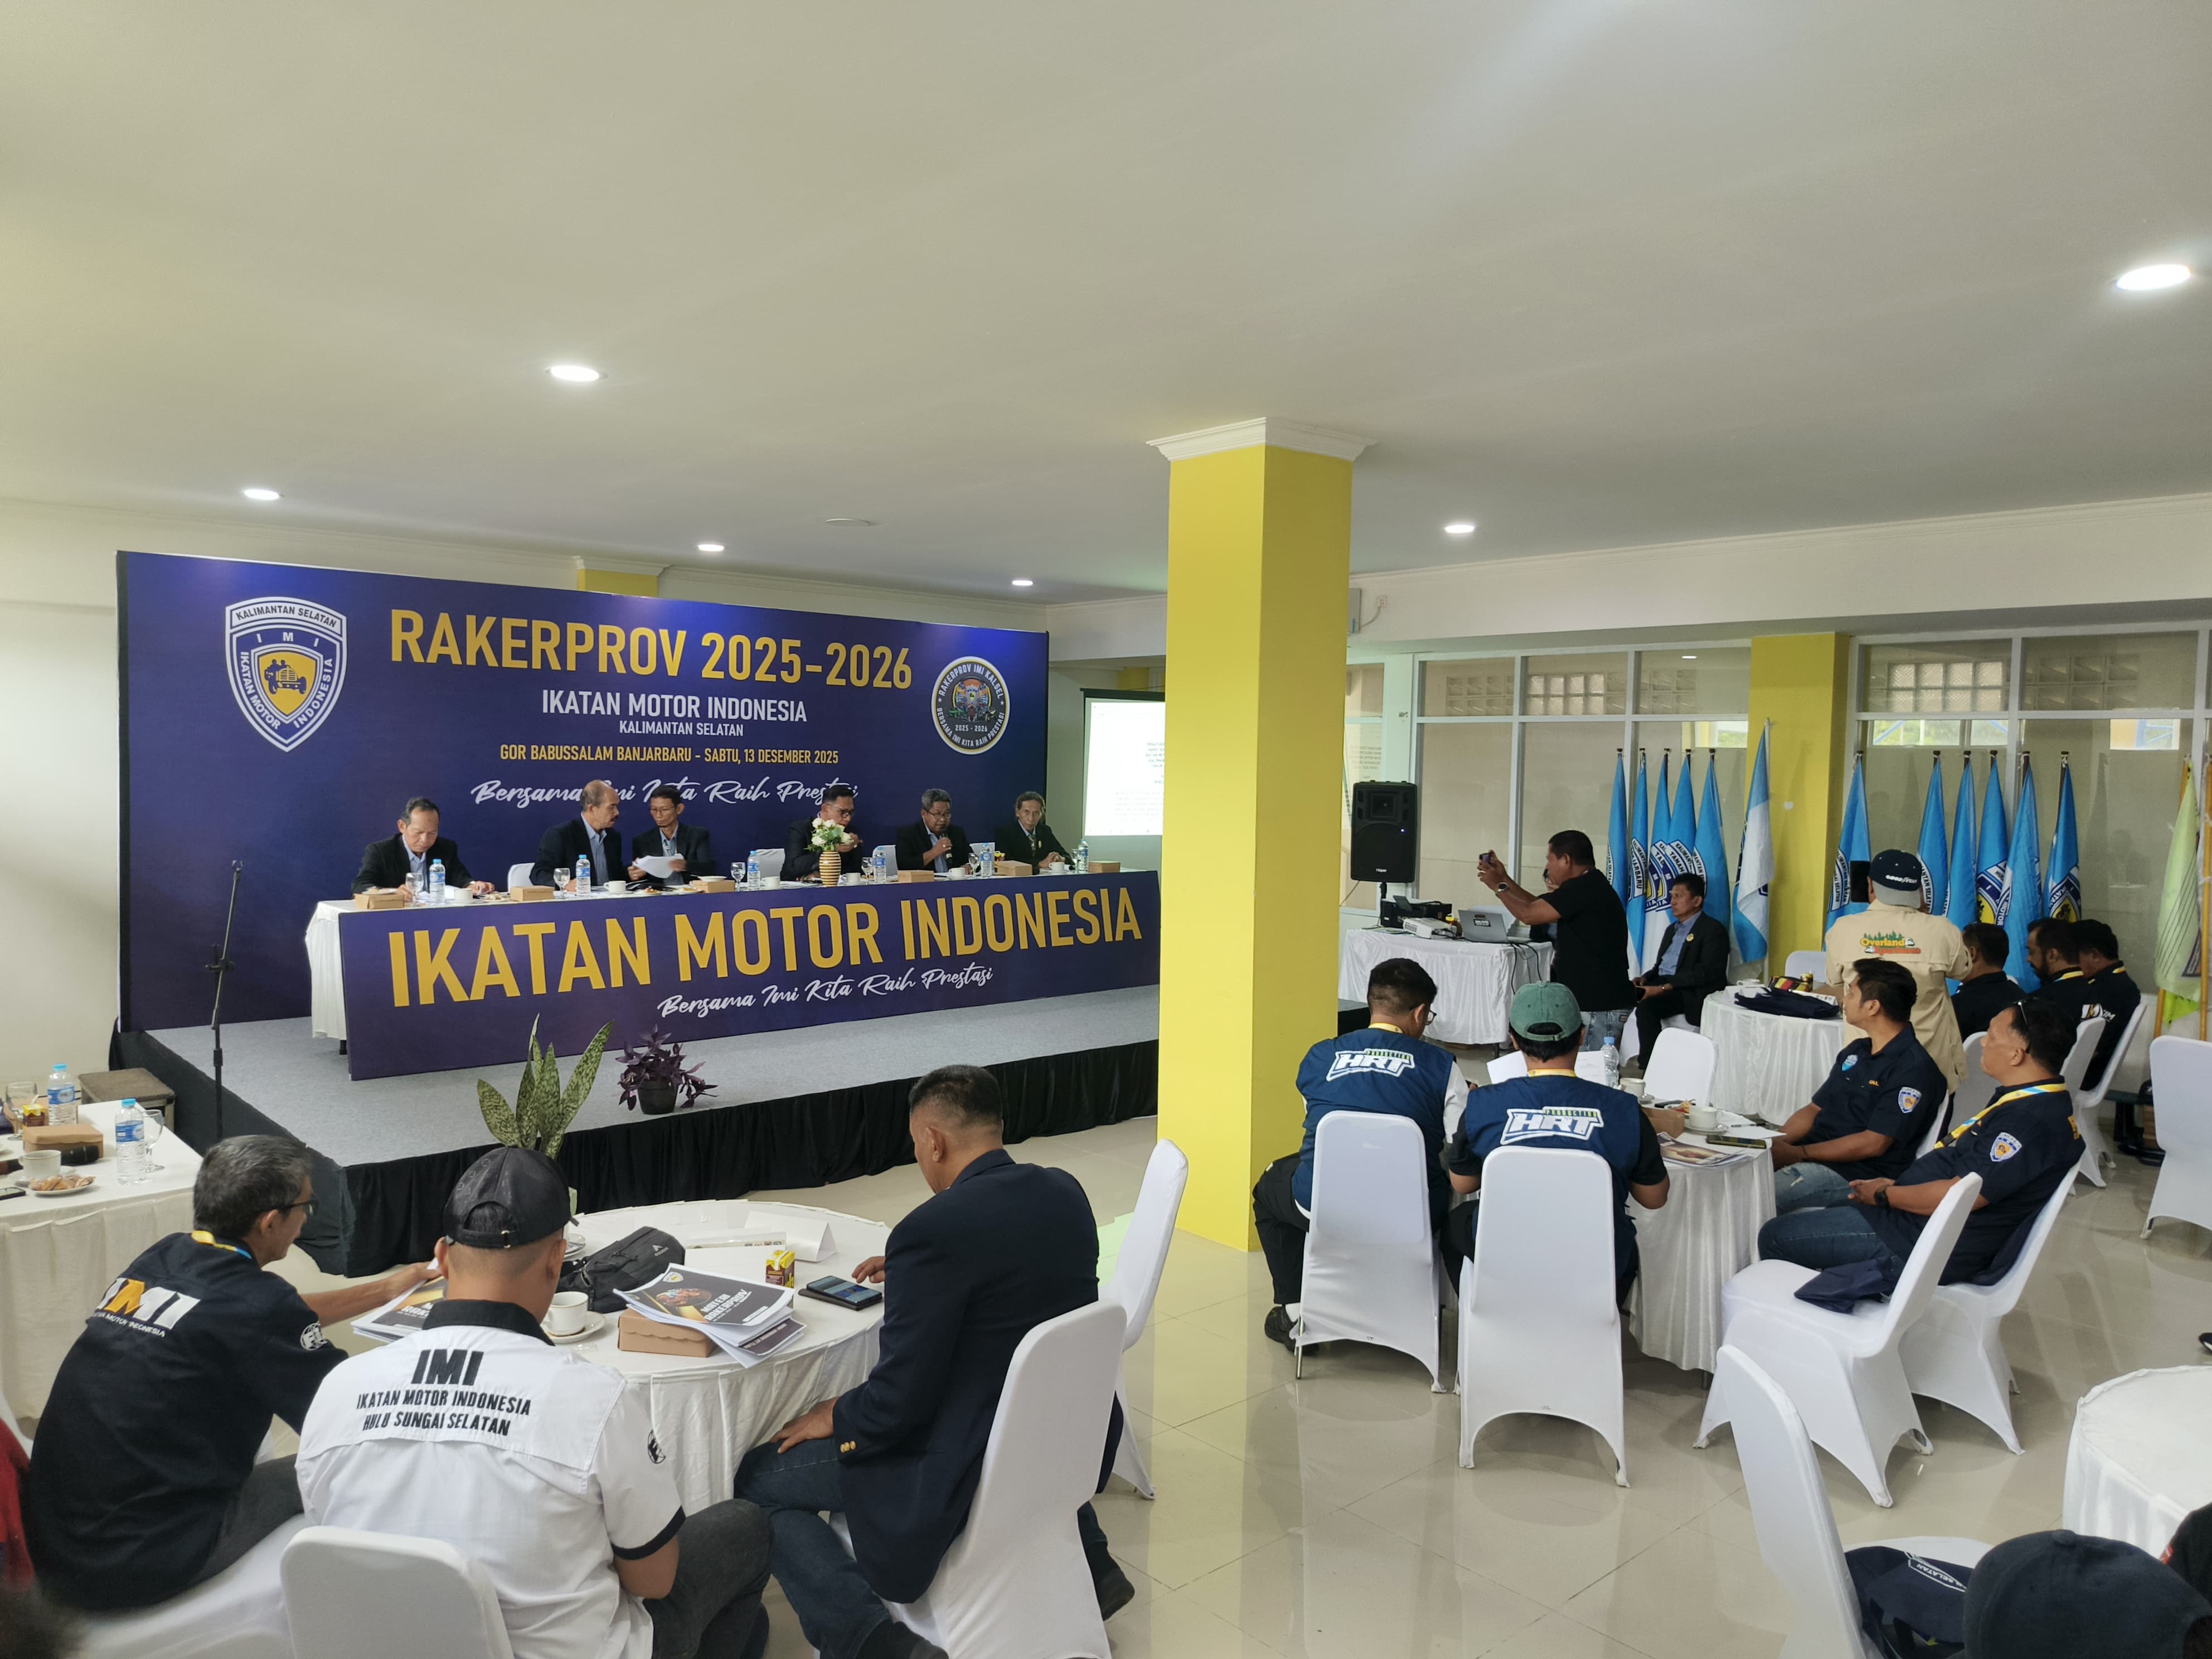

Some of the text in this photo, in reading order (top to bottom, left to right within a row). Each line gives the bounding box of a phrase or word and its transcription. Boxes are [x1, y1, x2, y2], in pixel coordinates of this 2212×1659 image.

[235, 605, 337, 628] KALIMANTAN SELATAN
[391, 609, 913, 689] RAKERPROV 2025-2026
[240, 651, 333, 729] IKATAN MOTOR INDONESIA
[938, 664, 1004, 699] RAKERPROV IMI KALSEL
[542, 690, 807, 722] IKATAN MOTOR INDONESIA
[619, 720, 744, 736] KALIMANTAN SELATAN
[937, 707, 952, 738] BERSAMA
[952, 734, 961, 744] IMI
[976, 737, 988, 746] RAIH
[987, 712, 1005, 740] PRESTASI
[500, 744, 526, 760] GOR
[531, 745, 613, 761] BABUSSALAM
[617, 746, 691, 761] BANJARBARU
[704, 748, 741, 764] SABTU,
[744, 749, 755, 763] 13
[758, 749, 811, 763] DESEMBER
[814, 750, 838, 764] 2025
[471, 779, 581, 808] Bersama
[704, 776, 770, 803] Raih
[1670, 852, 1685, 872] TANAH
[389, 887, 1142, 1007] IKATAN MOTOR INDONESIA
[1860, 937, 1905, 947] Overland
[657, 962, 993, 1018] Bersama Imi Kita Raih Prestasi
[1334, 1053, 1410, 1073] HRT
[1507, 1113, 1599, 1136] HRT
[411, 1348, 484, 1386] IMI
[356, 1389, 531, 1415] IKATAN MOTOR INDONESIA
[362, 1411, 511, 1436] HULU SUNGAI SELATAN
